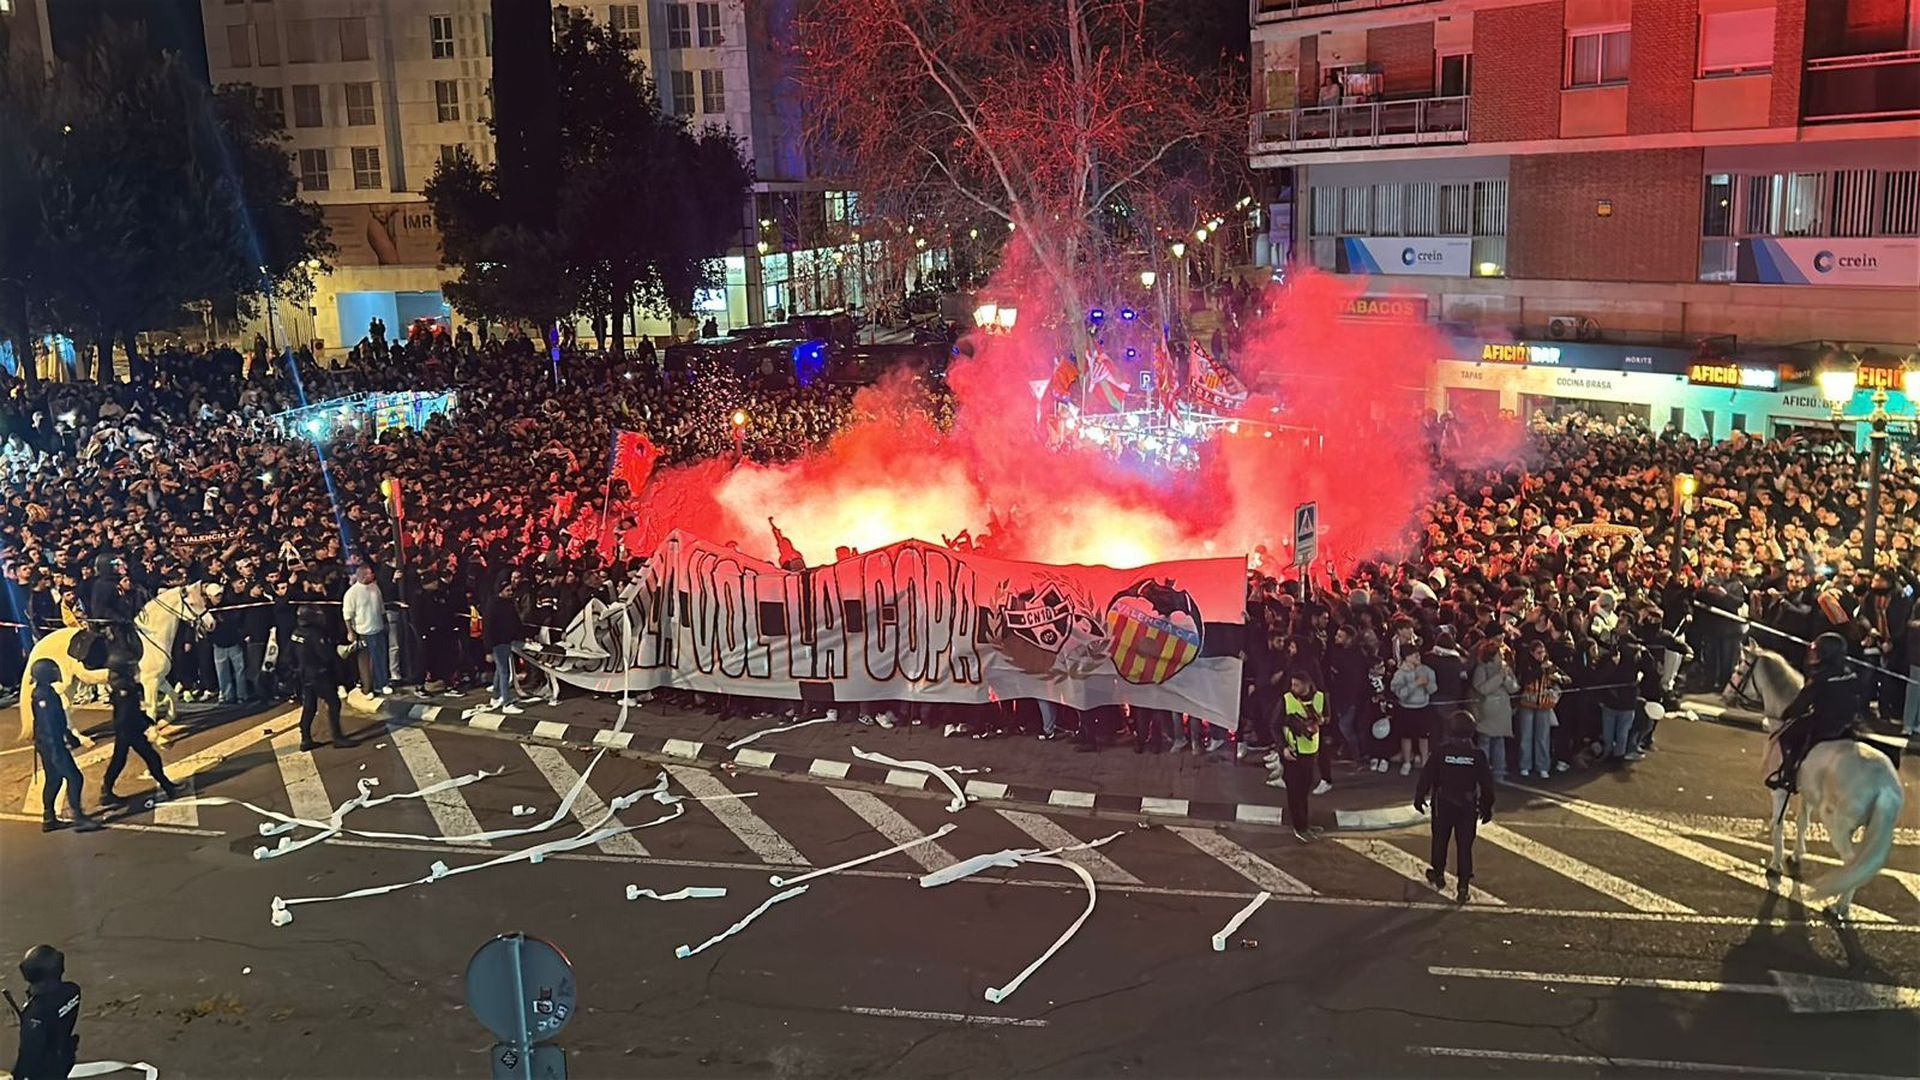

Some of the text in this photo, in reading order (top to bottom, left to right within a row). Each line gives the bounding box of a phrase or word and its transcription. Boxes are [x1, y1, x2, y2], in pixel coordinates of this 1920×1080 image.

[1417, 250, 1443, 261] crein
[1838, 254, 1877, 267] crein
[1338, 299, 1414, 315] TABACOS
[1461, 371, 1483, 380] TAPAS
[1557, 377, 1612, 390] COCINA BRASA
[182, 533, 226, 543] VALENCIA
[688, 549, 769, 679] VOL
[784, 564, 847, 679] LA
[864, 547, 982, 684] COPA
[1116, 603, 1172, 631] VALENCIA
